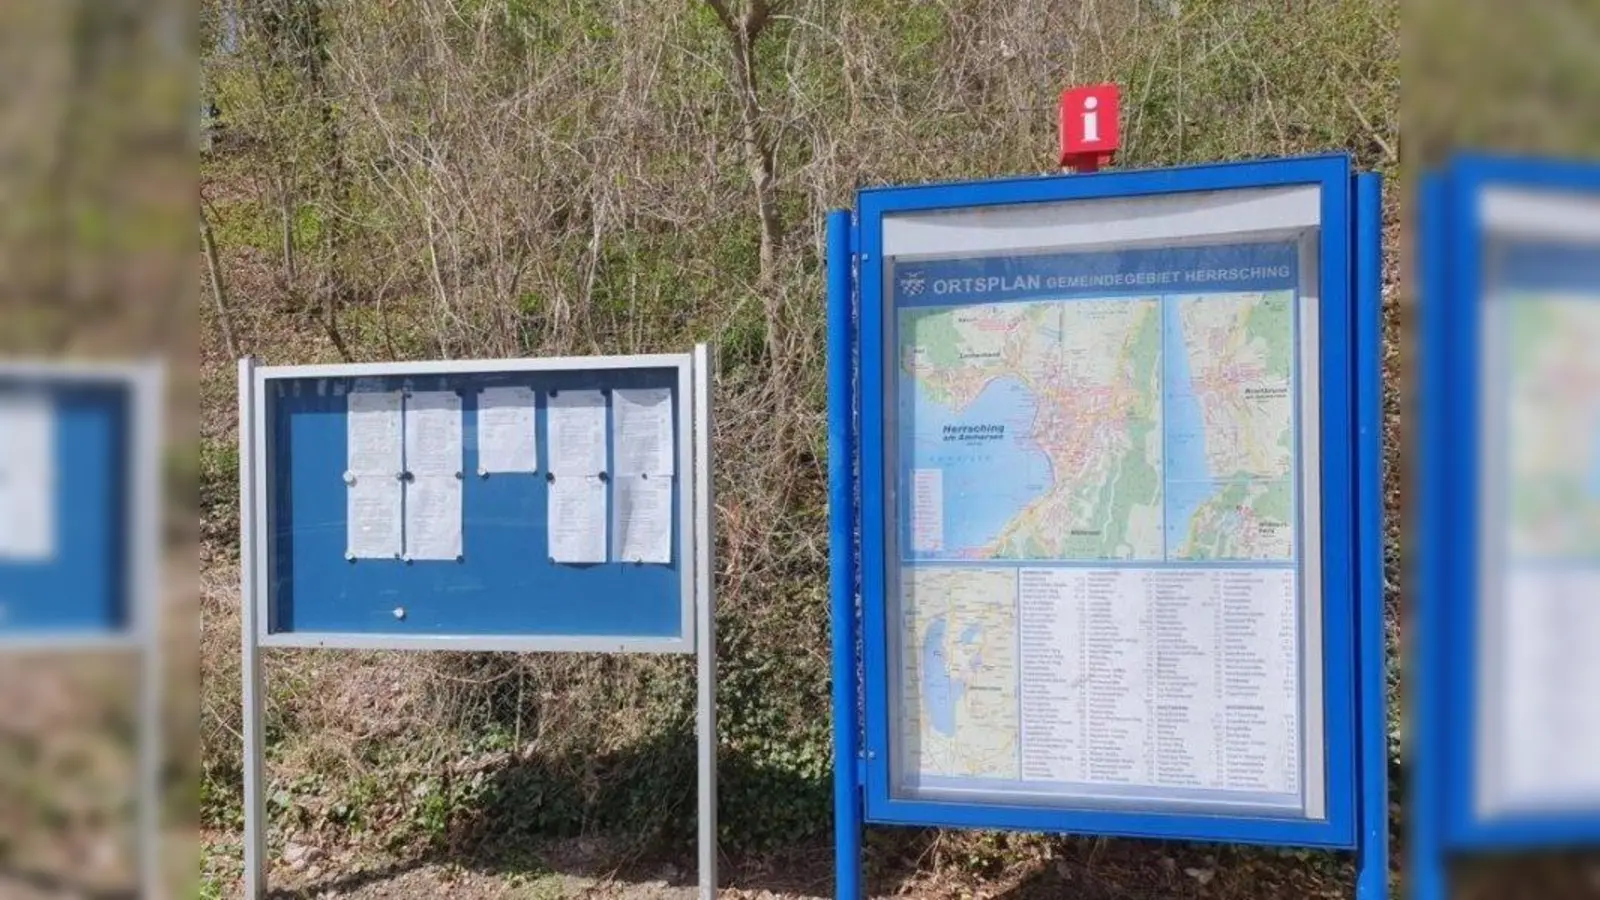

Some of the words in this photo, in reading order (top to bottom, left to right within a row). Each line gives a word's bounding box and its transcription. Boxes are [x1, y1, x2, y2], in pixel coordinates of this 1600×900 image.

[1080, 96, 1101, 143] i
[933, 275, 1041, 295] ORTSPLAN
[1046, 271, 1181, 288] GEMEINDEGEBIET
[1185, 265, 1291, 282] HERRSCHING
[942, 424, 1005, 435] Herrsching
